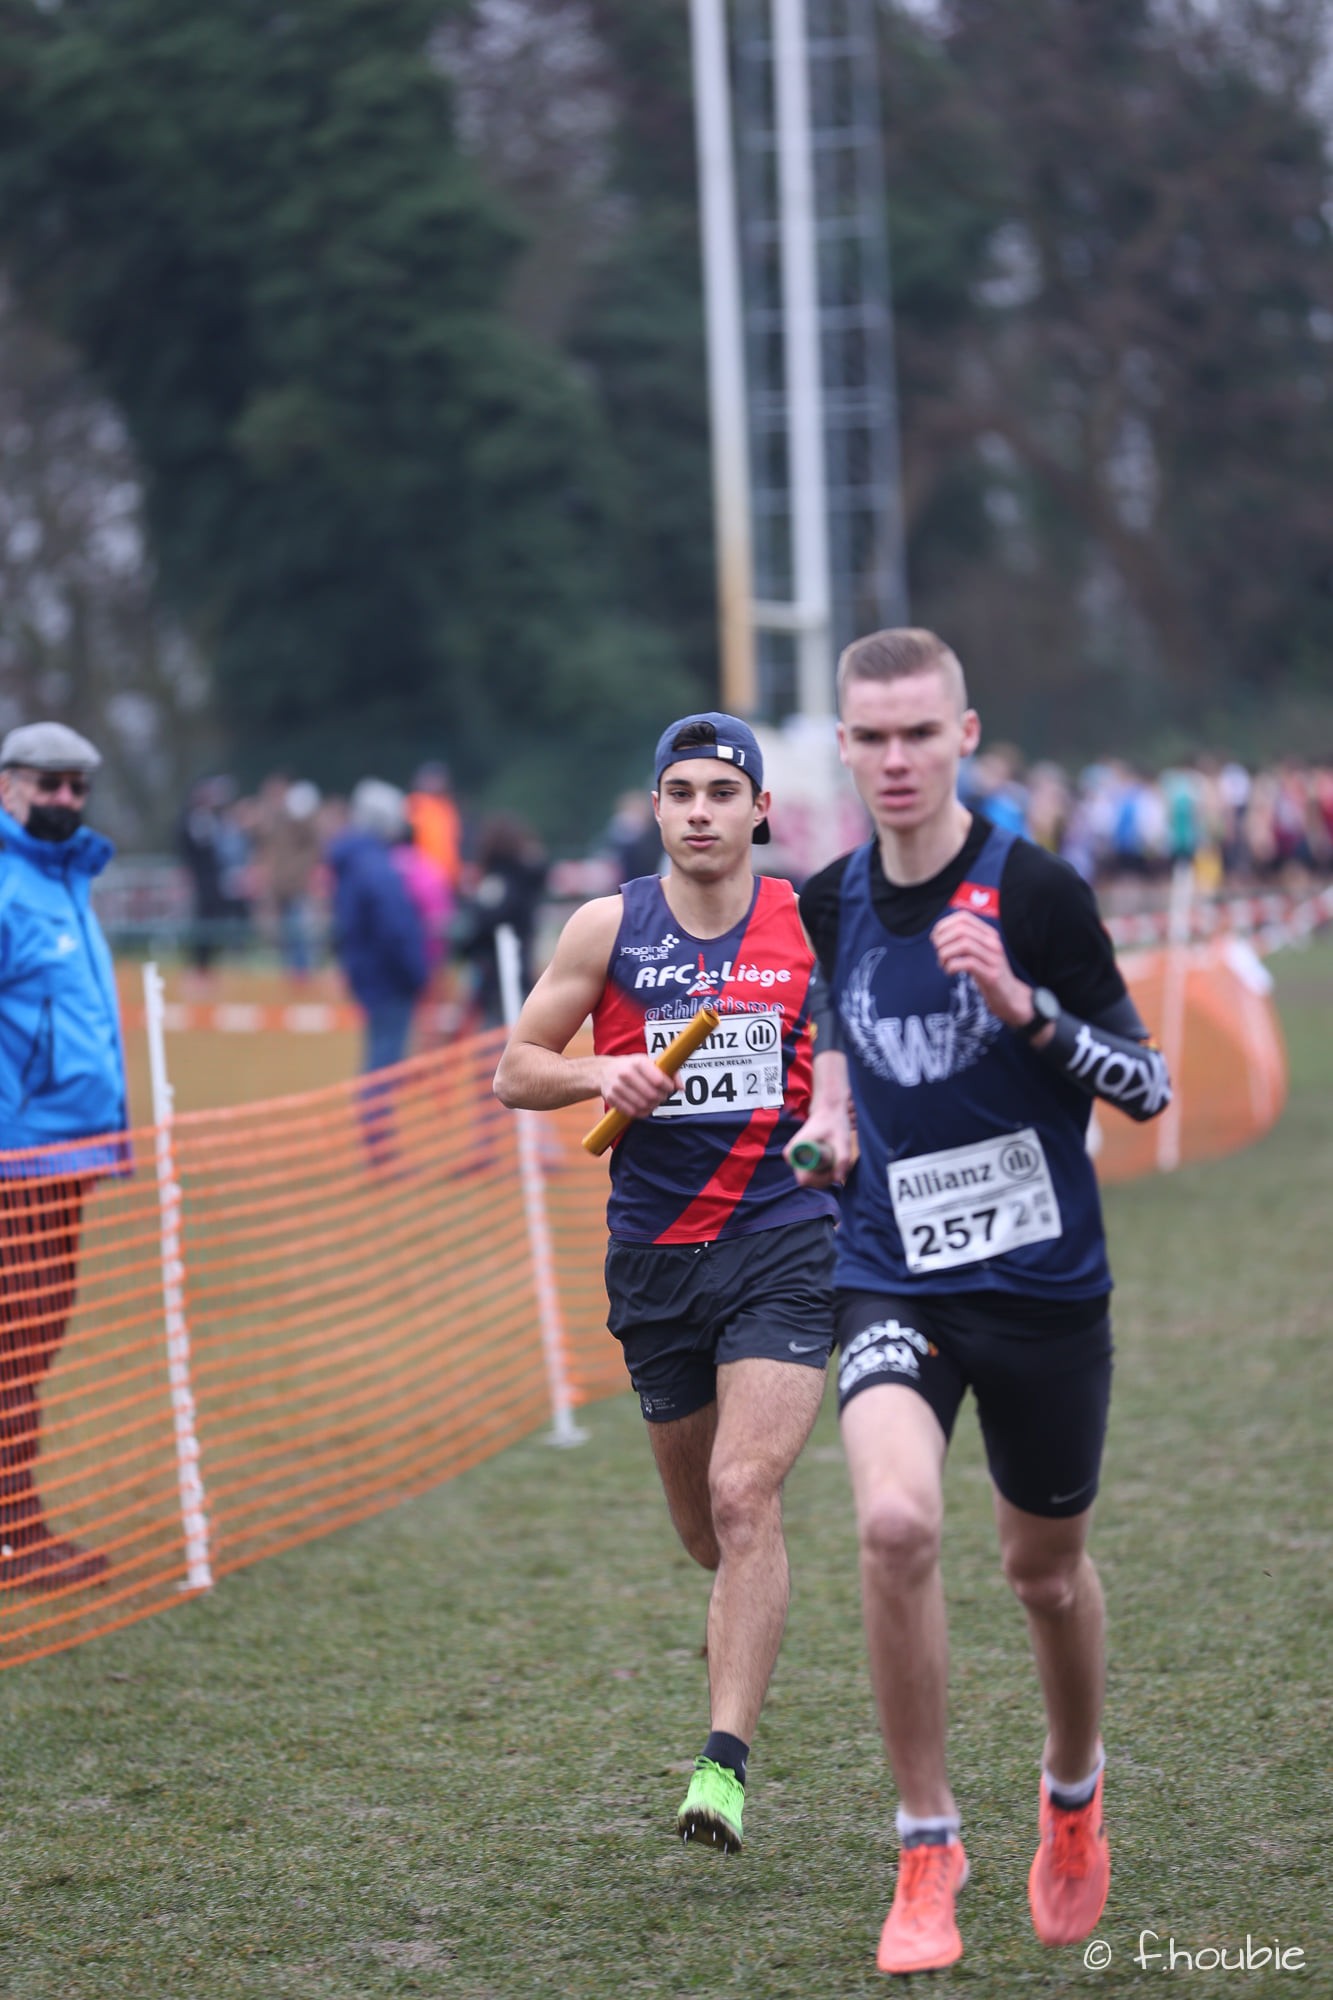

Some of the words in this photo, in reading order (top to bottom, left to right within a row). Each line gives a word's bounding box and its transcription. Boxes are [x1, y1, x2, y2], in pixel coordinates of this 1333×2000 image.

[620, 946, 670, 957] jogging
[639, 954, 669, 963] plus
[634, 963, 695, 989] RFC
[720, 961, 792, 988] Liège
[745, 1073, 759, 1095] 2
[898, 1164, 993, 1201] Allianz
[912, 1208, 997, 1257] 257
